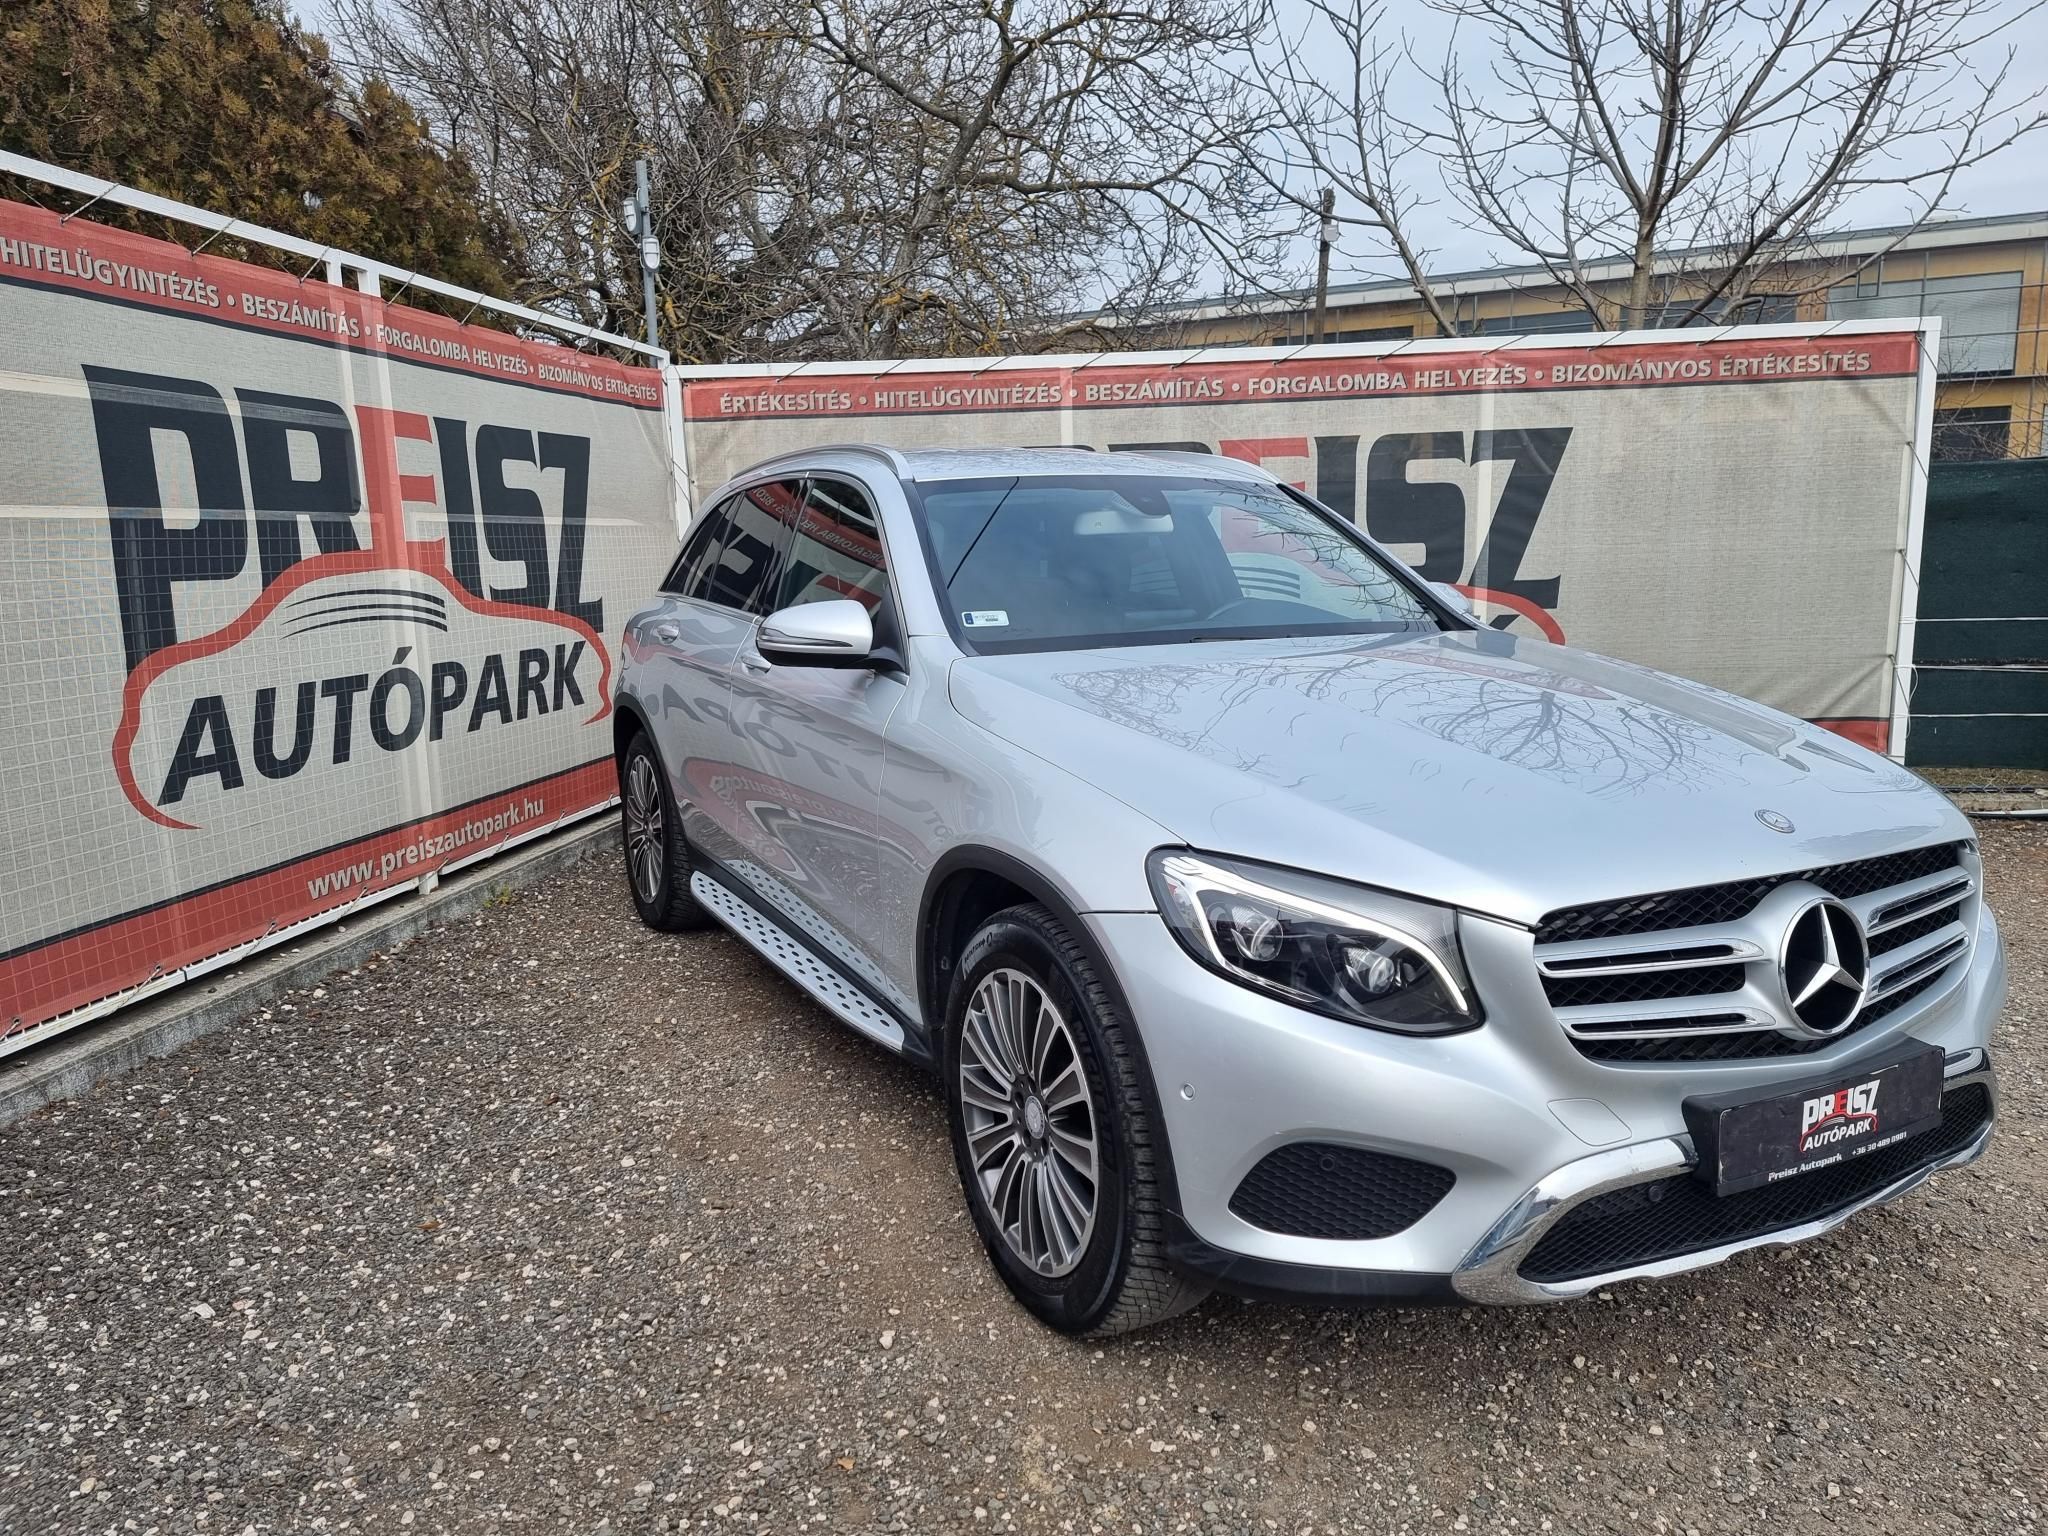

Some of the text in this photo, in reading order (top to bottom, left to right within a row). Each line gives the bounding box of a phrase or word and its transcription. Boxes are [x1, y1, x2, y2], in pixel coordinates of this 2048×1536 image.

[0, 237, 219, 308] HITELÜGYINTÉZÉS
[242, 293, 360, 338] BESZÁMÍTÁS
[376, 323, 470, 363] FORGALOMBA
[473, 346, 528, 375] HELYEZÉS
[538, 363, 603, 391] BIZOMÁNYOS
[720, 353, 1871, 414] ÉRTÉKESÍTÉS HITELÜGYINTÉZÉS BESZÁMÍTÁS FORGALOMBA HELYEZÉS BIZOMÁNYOS ÉRTÉKESÍTÉS
[81, 363, 603, 678] PREISZ
[157, 641, 586, 806] AUTÓPARK
[307, 798, 544, 900] www.preiszautopark.hu
[1802, 1079, 1881, 1133] PREISZ
[1803, 1118, 1872, 1151] AUTÓPARK
[1768, 1166, 1798, 1182] Preisz
[1799, 1153, 1843, 1173] Autopark
